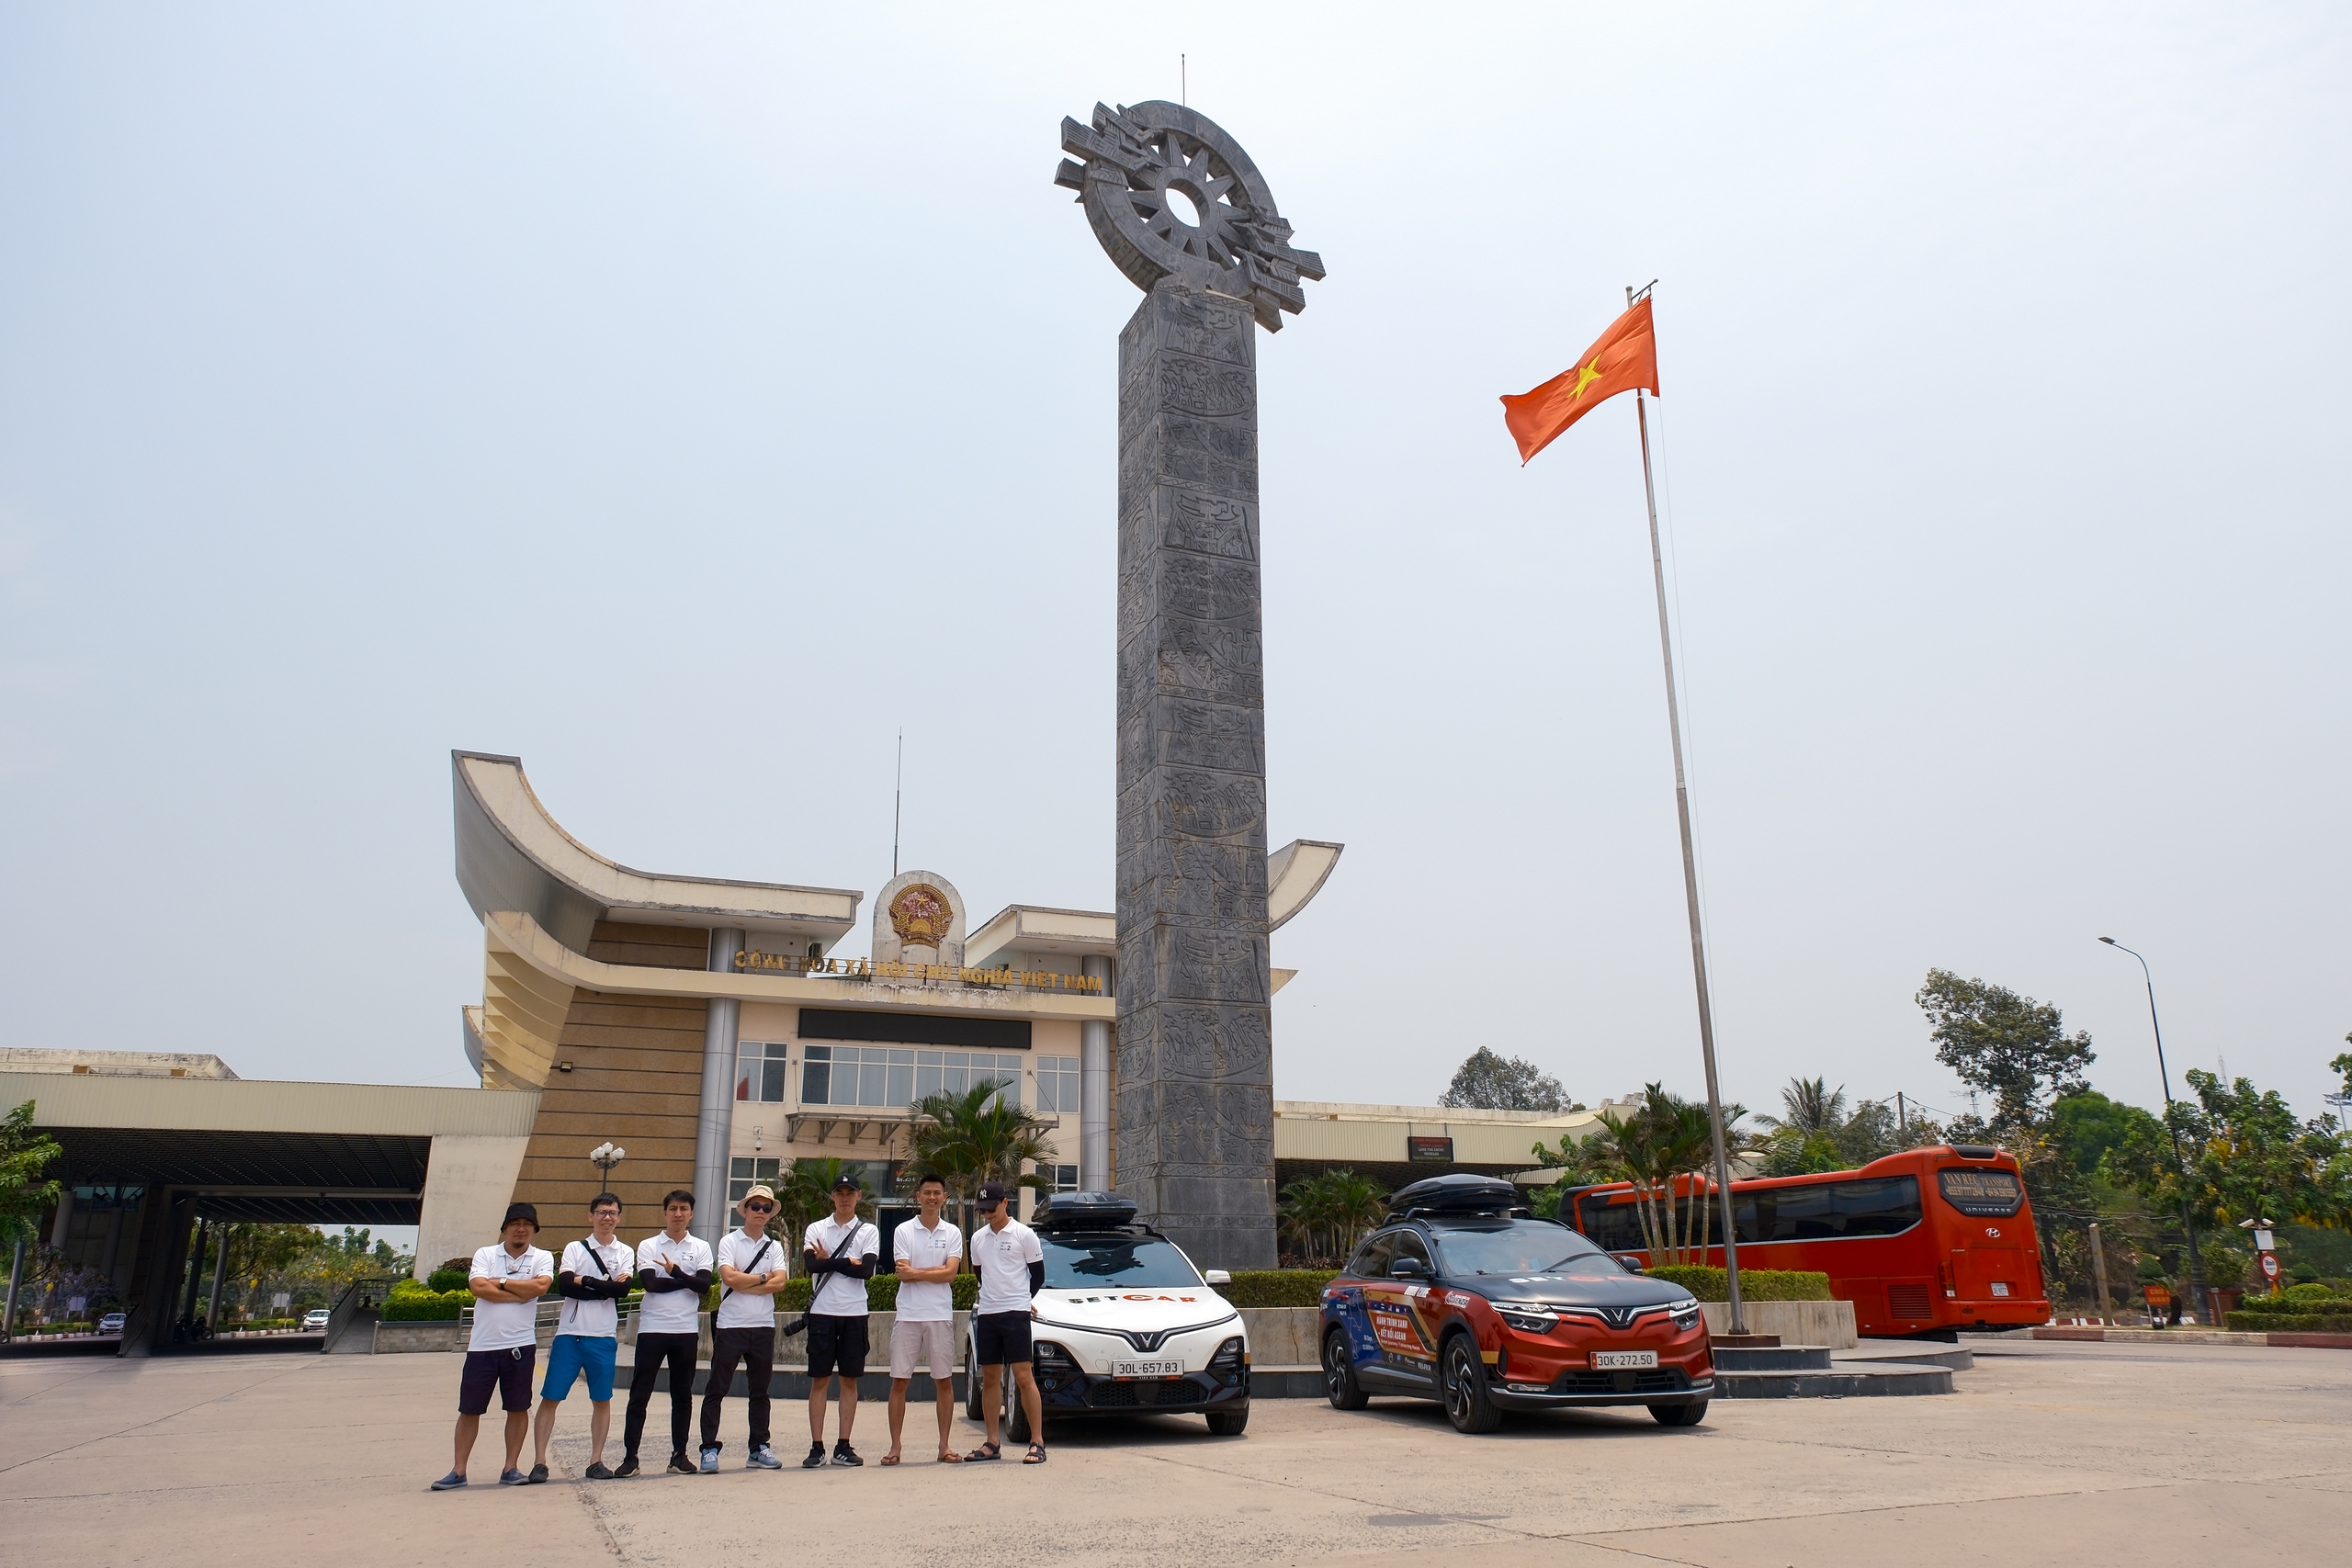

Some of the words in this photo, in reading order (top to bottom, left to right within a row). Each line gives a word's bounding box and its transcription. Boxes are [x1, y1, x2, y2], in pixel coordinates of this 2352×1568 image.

[844, 956, 870, 976] XÃ
[876, 959, 909, 981] HỘI
[913, 961, 952, 981] CHỦ
[958, 965, 1012, 986] NGHĨA
[1019, 969, 1059, 991] VIỆT
[1064, 974, 1102, 991] NAM
[1944, 1173, 1962, 1185] VAN
[1597, 1354, 1653, 1367] 30K-272.50
[1118, 1362, 1178, 1374] 30L-657.83
